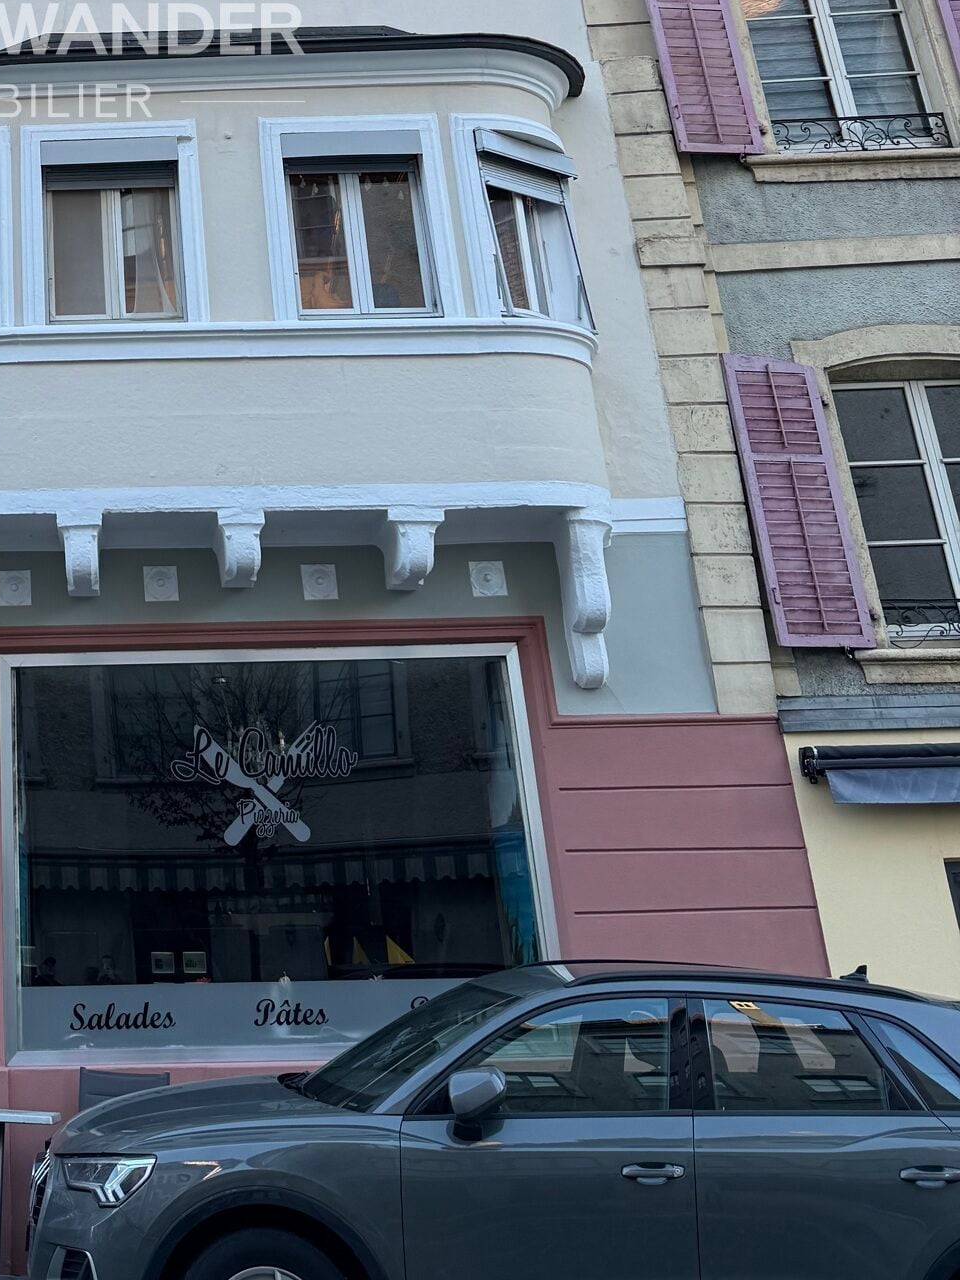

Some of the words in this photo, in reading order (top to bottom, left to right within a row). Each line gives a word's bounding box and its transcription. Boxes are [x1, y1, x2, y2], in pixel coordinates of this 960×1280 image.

[171, 726, 230, 785] Le
[237, 798, 301, 837] Pizzeria
[69, 1001, 176, 1031] Salades
[253, 997, 329, 1028] Pâtes
